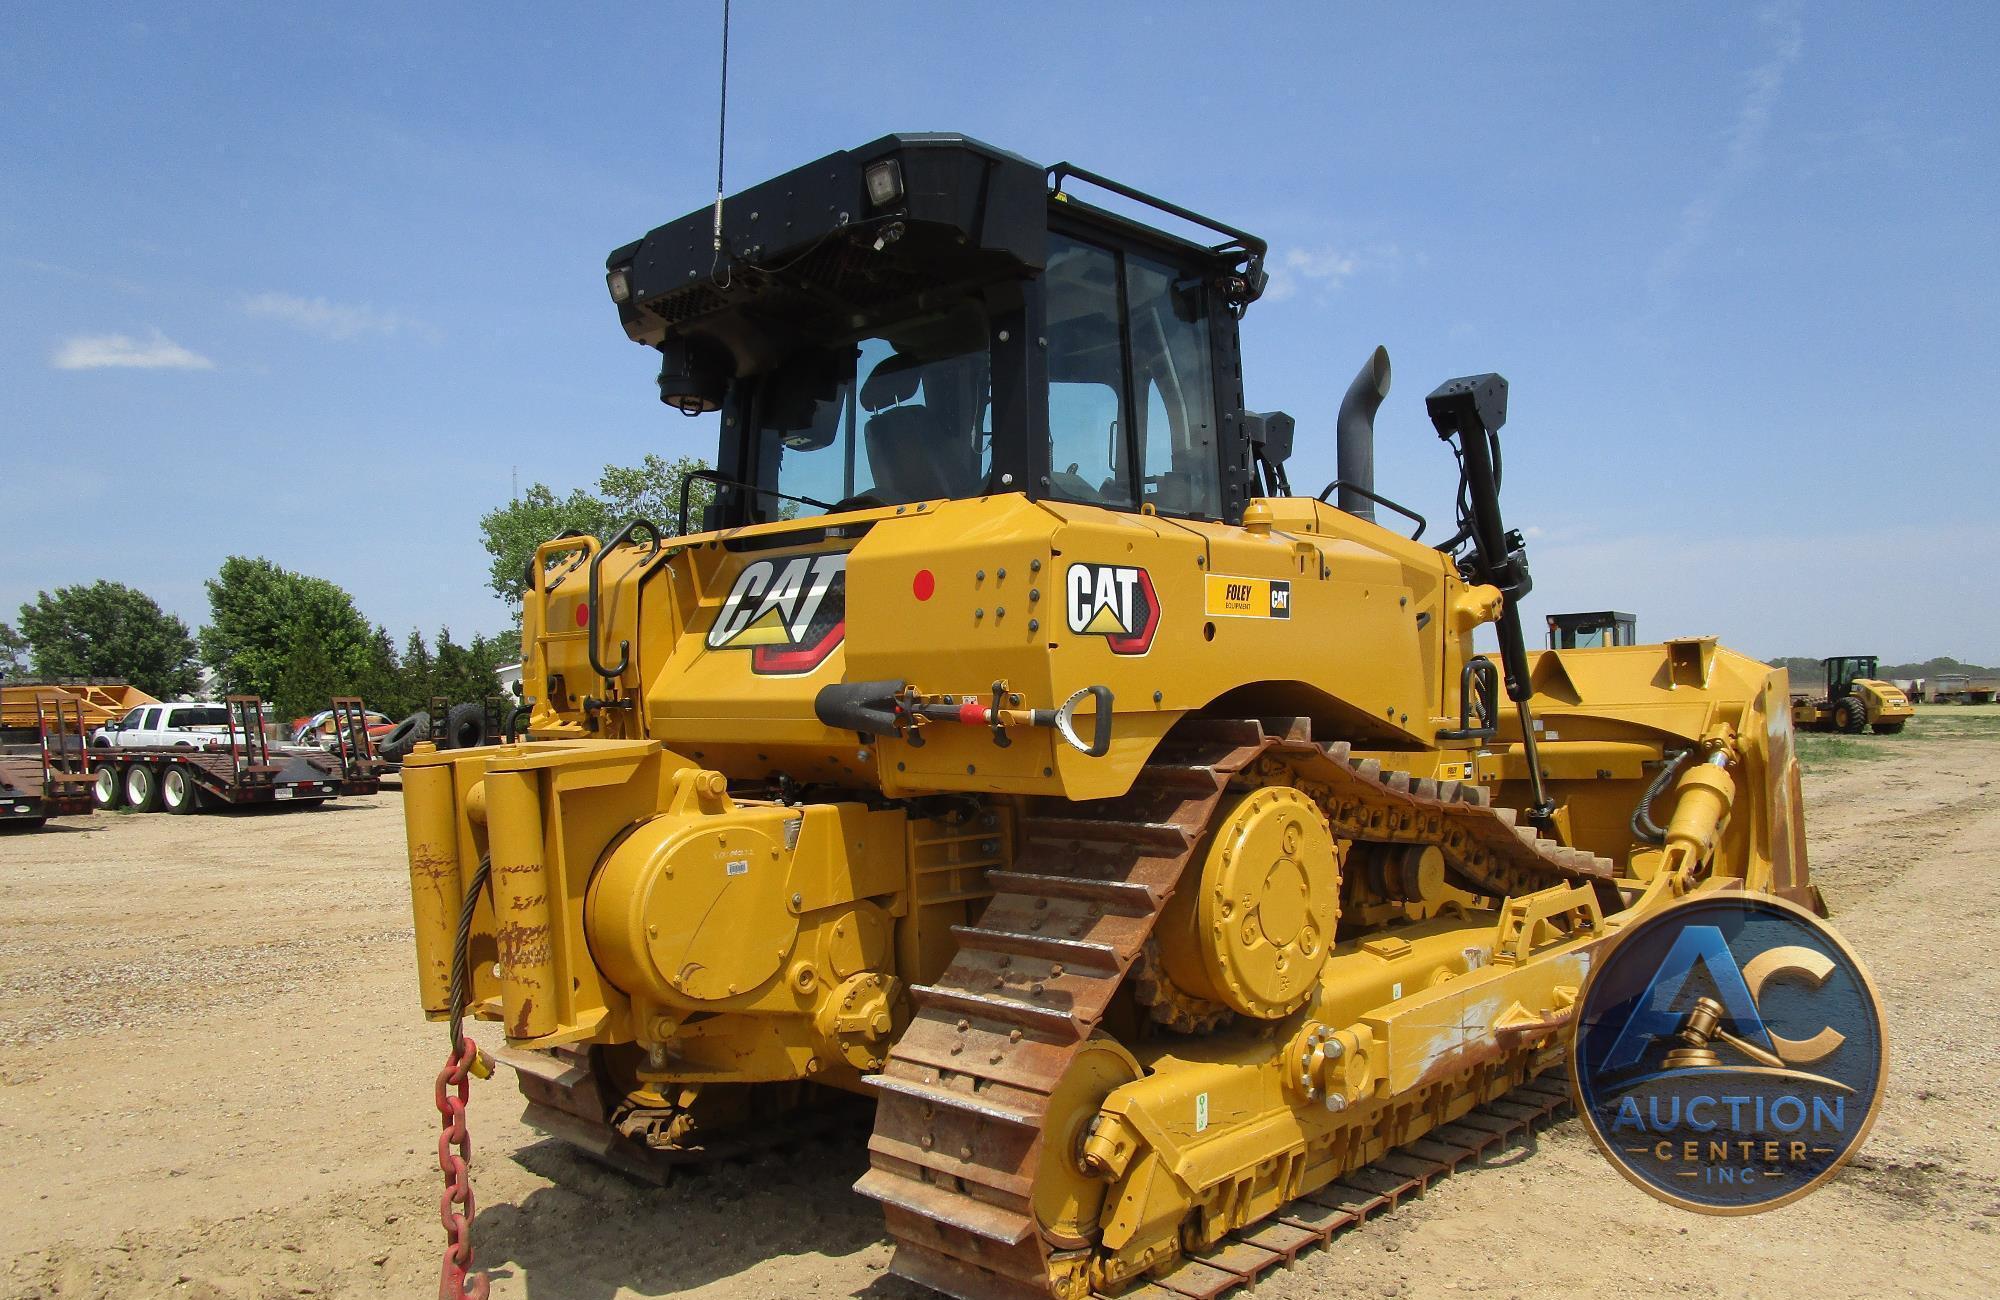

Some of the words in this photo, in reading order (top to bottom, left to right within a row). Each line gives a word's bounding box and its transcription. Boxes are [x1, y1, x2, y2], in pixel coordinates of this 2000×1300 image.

[708, 554, 847, 647] CAT
[1067, 563, 1138, 633] CAT
[1225, 584, 1252, 602] FOLEY
[1271, 590, 1289, 609] CAT
[1225, 602, 1251, 611] EQUIPMENT
